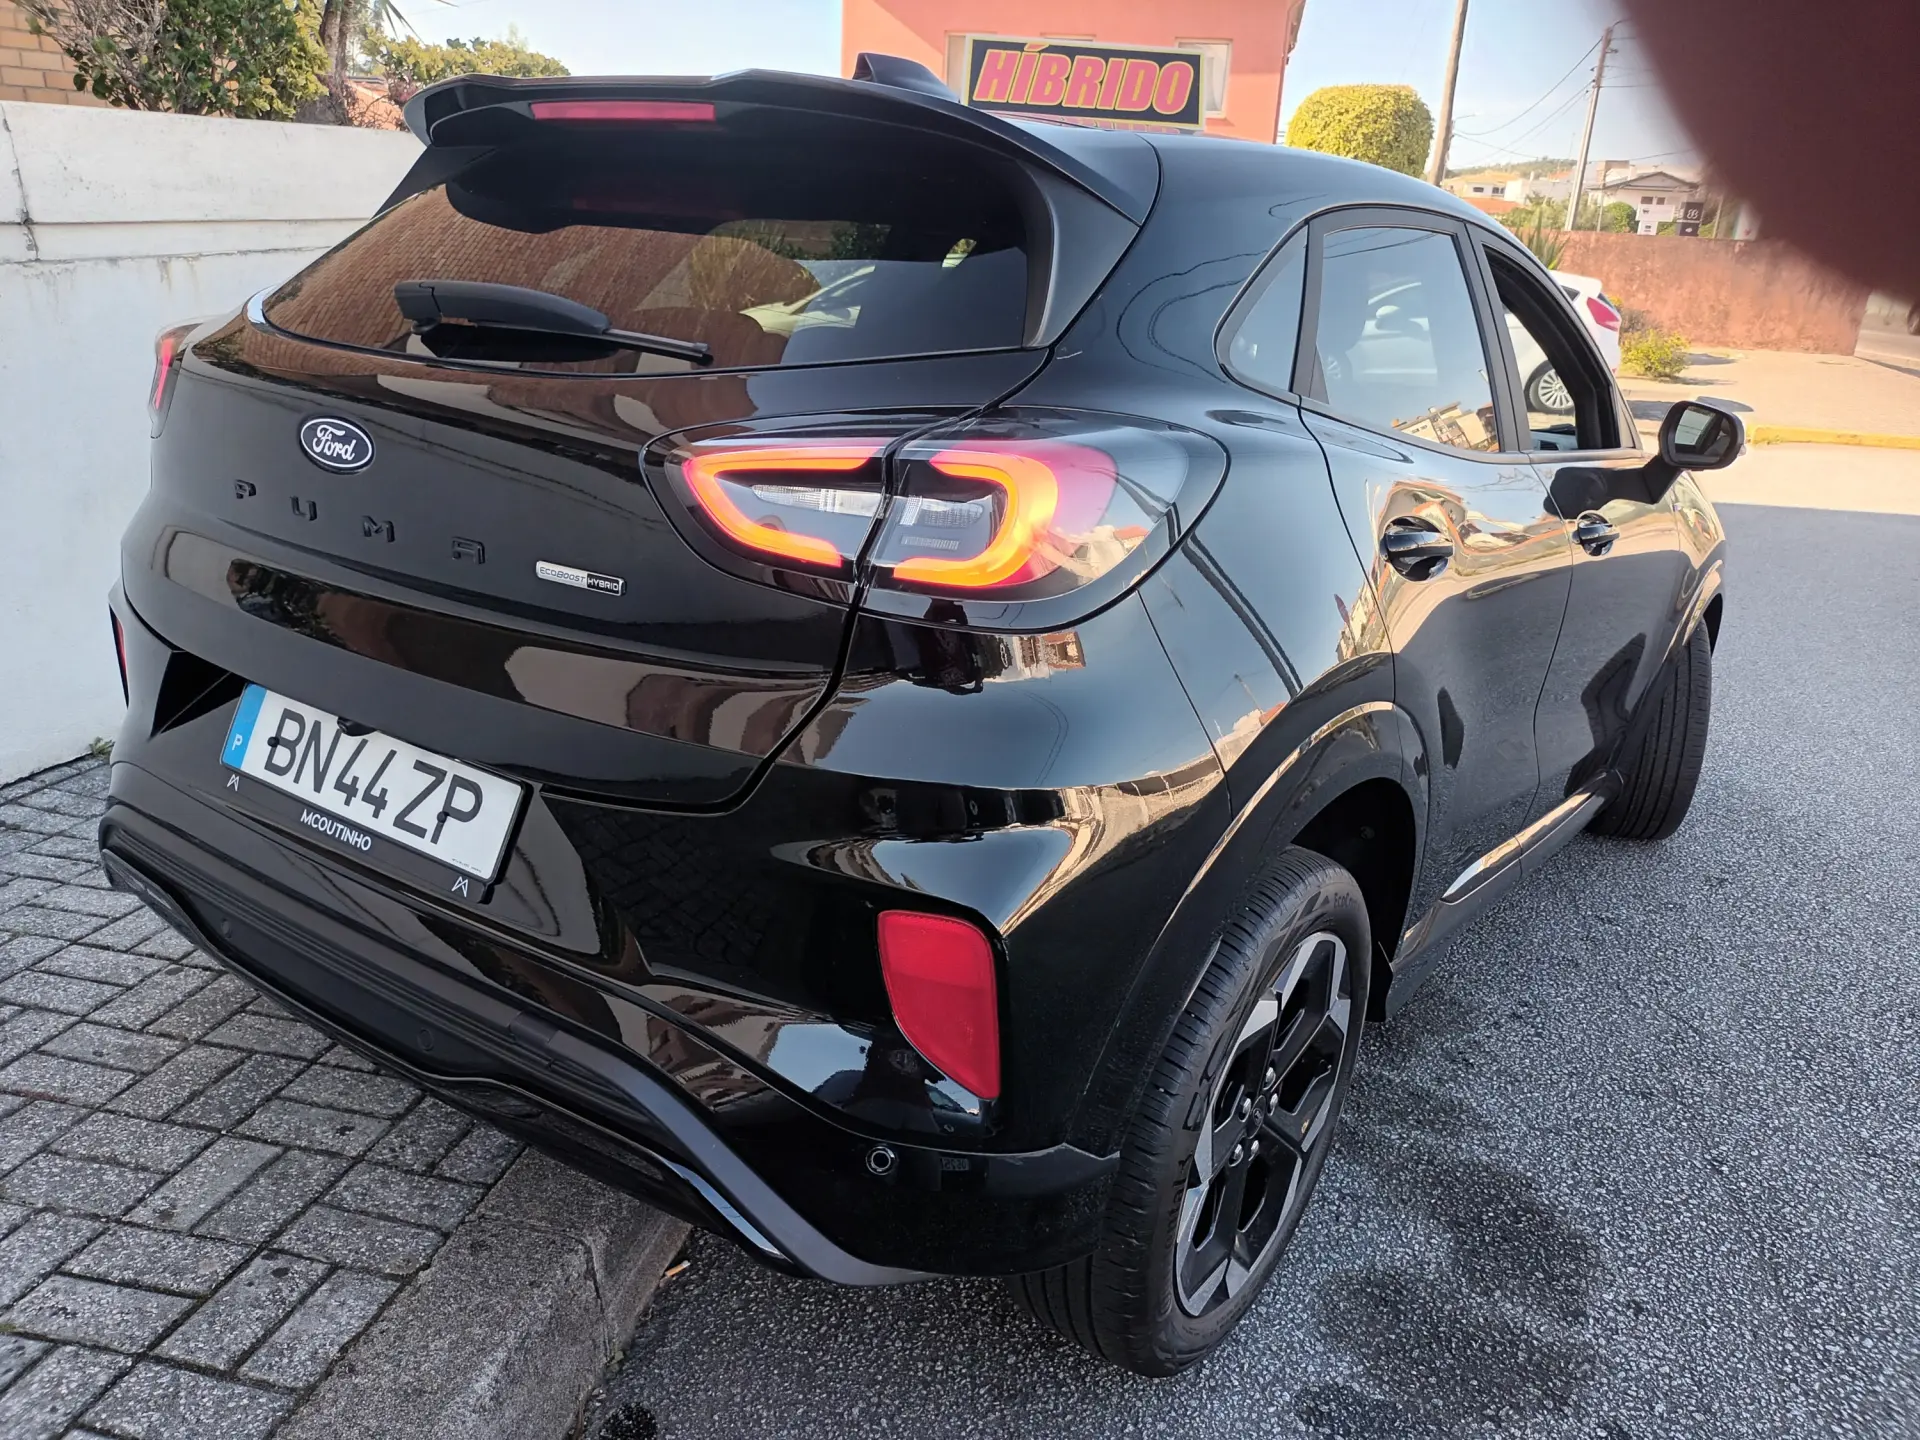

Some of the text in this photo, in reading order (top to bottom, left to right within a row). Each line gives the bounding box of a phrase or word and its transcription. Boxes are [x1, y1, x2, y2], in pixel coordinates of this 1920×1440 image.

[972, 42, 1194, 115] HÍBRIDO
[312, 424, 358, 461] Ford
[234, 479, 486, 565] PUMA
[587, 577, 619, 591] HYBRID
[231, 733, 243, 751] P
[300, 808, 372, 851] MCOUTINHO
